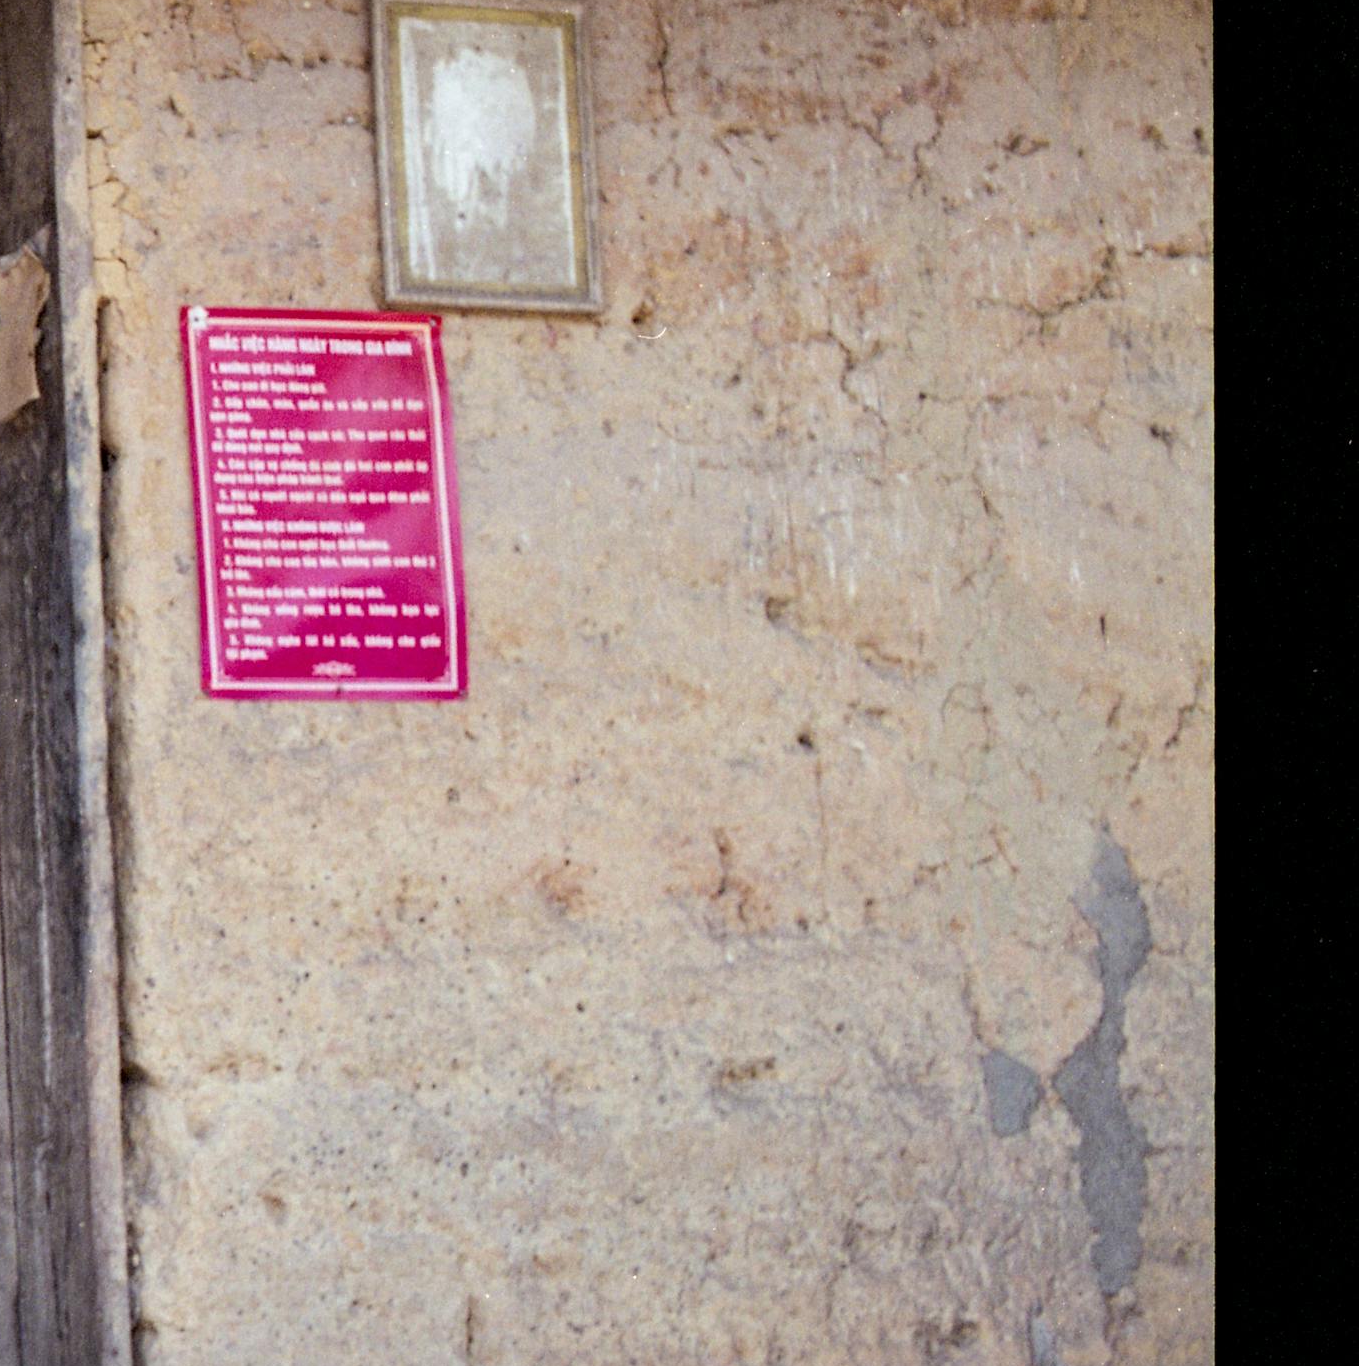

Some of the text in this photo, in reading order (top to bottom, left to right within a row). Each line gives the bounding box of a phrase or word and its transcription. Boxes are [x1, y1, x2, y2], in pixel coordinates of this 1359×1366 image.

[241, 335, 265, 353] VIỆC
[299, 336, 327, 353] NGÀY
[329, 339, 363, 354] TRONG
[366, 339, 383, 355] GIA
